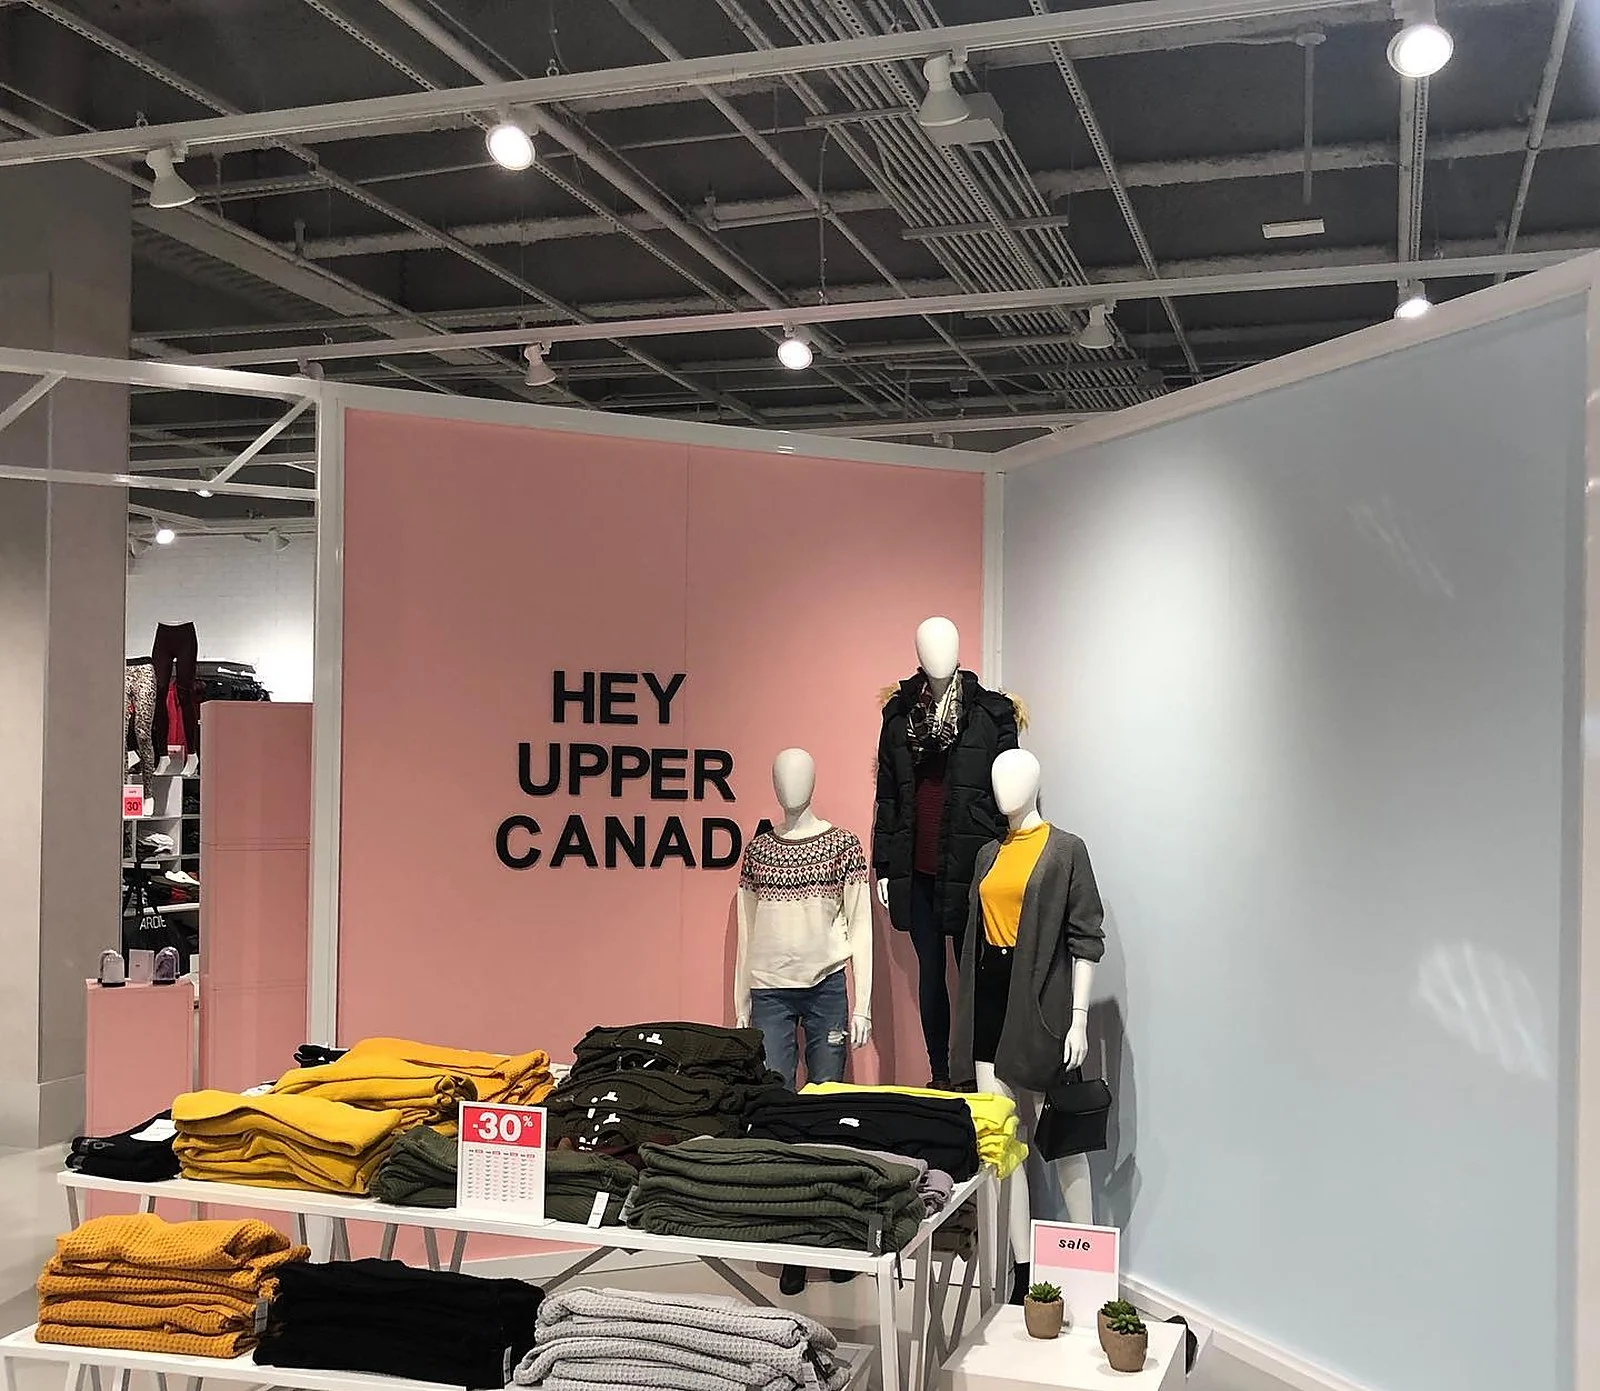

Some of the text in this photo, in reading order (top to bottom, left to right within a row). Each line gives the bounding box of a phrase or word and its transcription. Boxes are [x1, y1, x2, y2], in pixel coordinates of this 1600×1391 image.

[552, 670, 687, 725] HEY
[517, 742, 737, 802] UPPER
[495, 814, 775, 869] CANAD
[1058, 1238, 1091, 1251] sale
